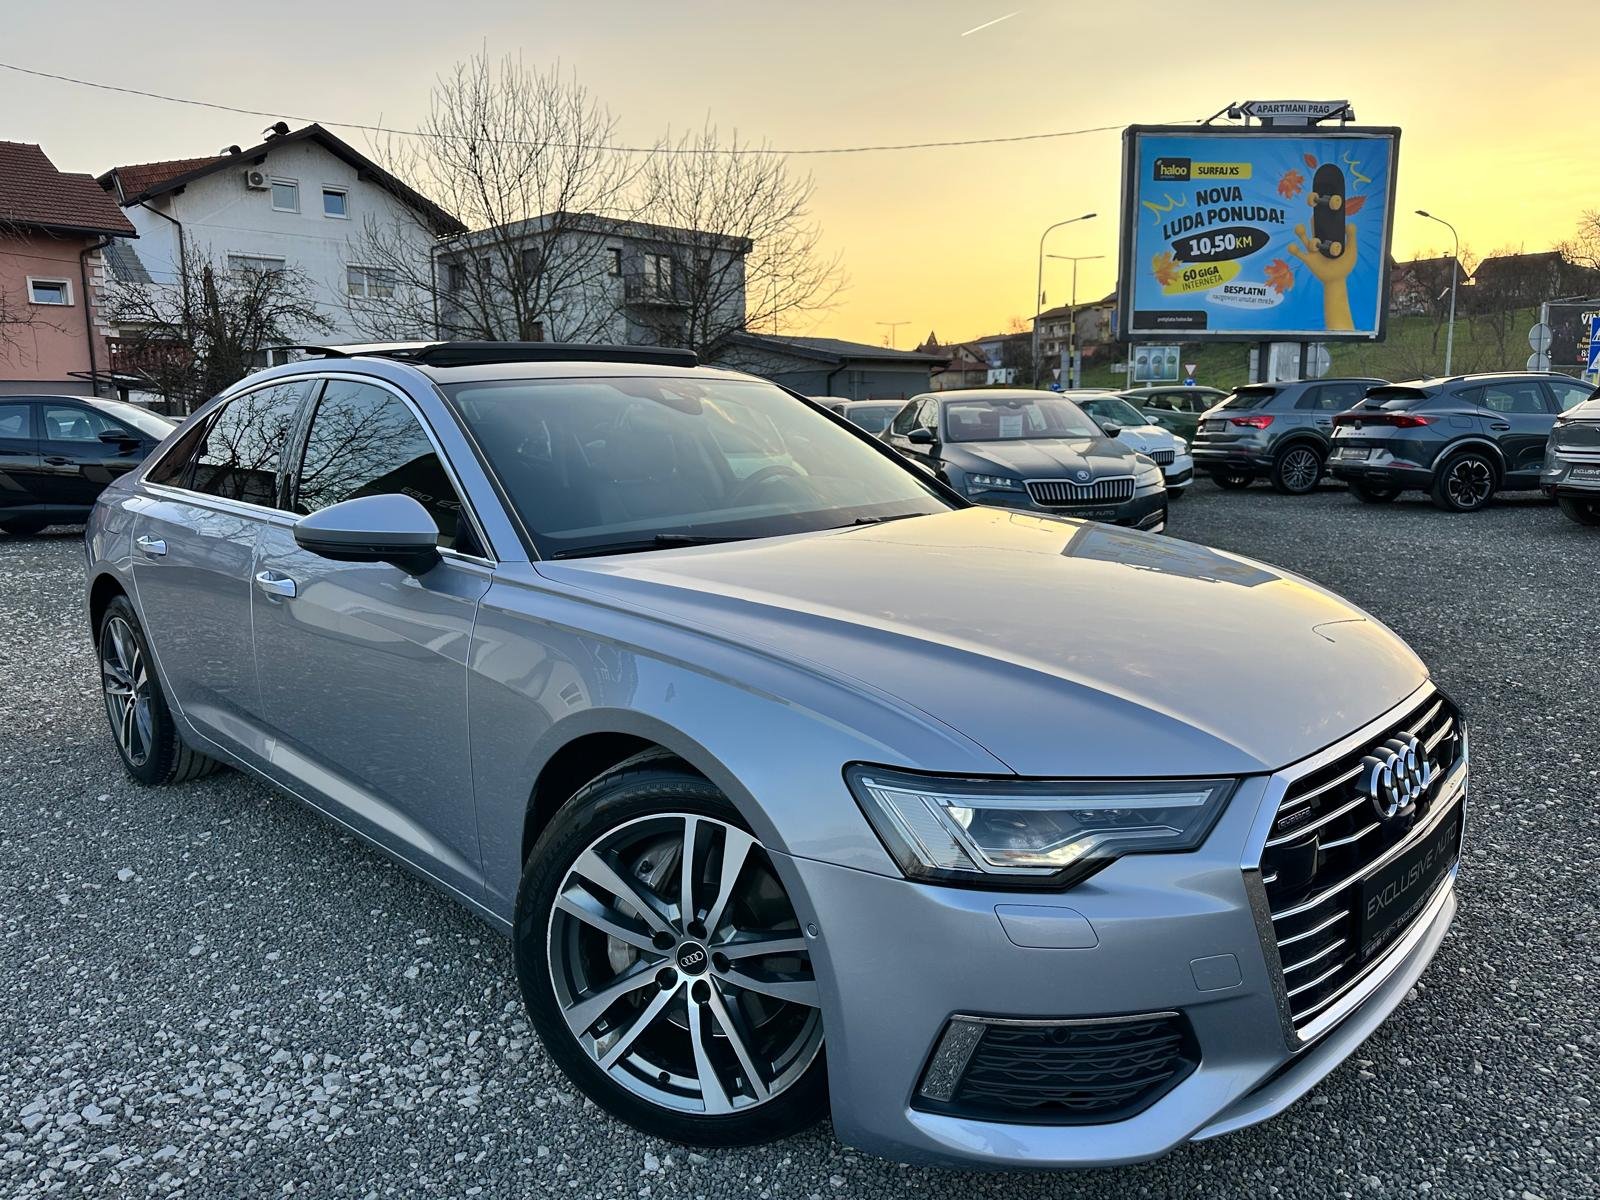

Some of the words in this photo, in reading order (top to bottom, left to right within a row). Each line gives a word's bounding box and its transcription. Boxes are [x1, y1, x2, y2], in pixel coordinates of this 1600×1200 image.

[1257, 104, 1307, 113] APARTMANI
[1308, 104, 1330, 114] PRAG
[1160, 165, 1187, 175] haloo
[1198, 166, 1228, 175] SURFAJ
[1229, 166, 1240, 175] XS
[1196, 186, 1243, 207] NOVA
[1163, 212, 1205, 240] LUDA
[1207, 206, 1285, 225] PONUDA!
[1183, 269, 1197, 281] 60
[1198, 265, 1219, 278] GIGA
[1182, 274, 1223, 291] INTERNETA
[1224, 285, 1266, 296] BESPLATNI
[1366, 848, 1433, 921] EXCLUSIVE
[1434, 820, 1457, 860] AUTO
